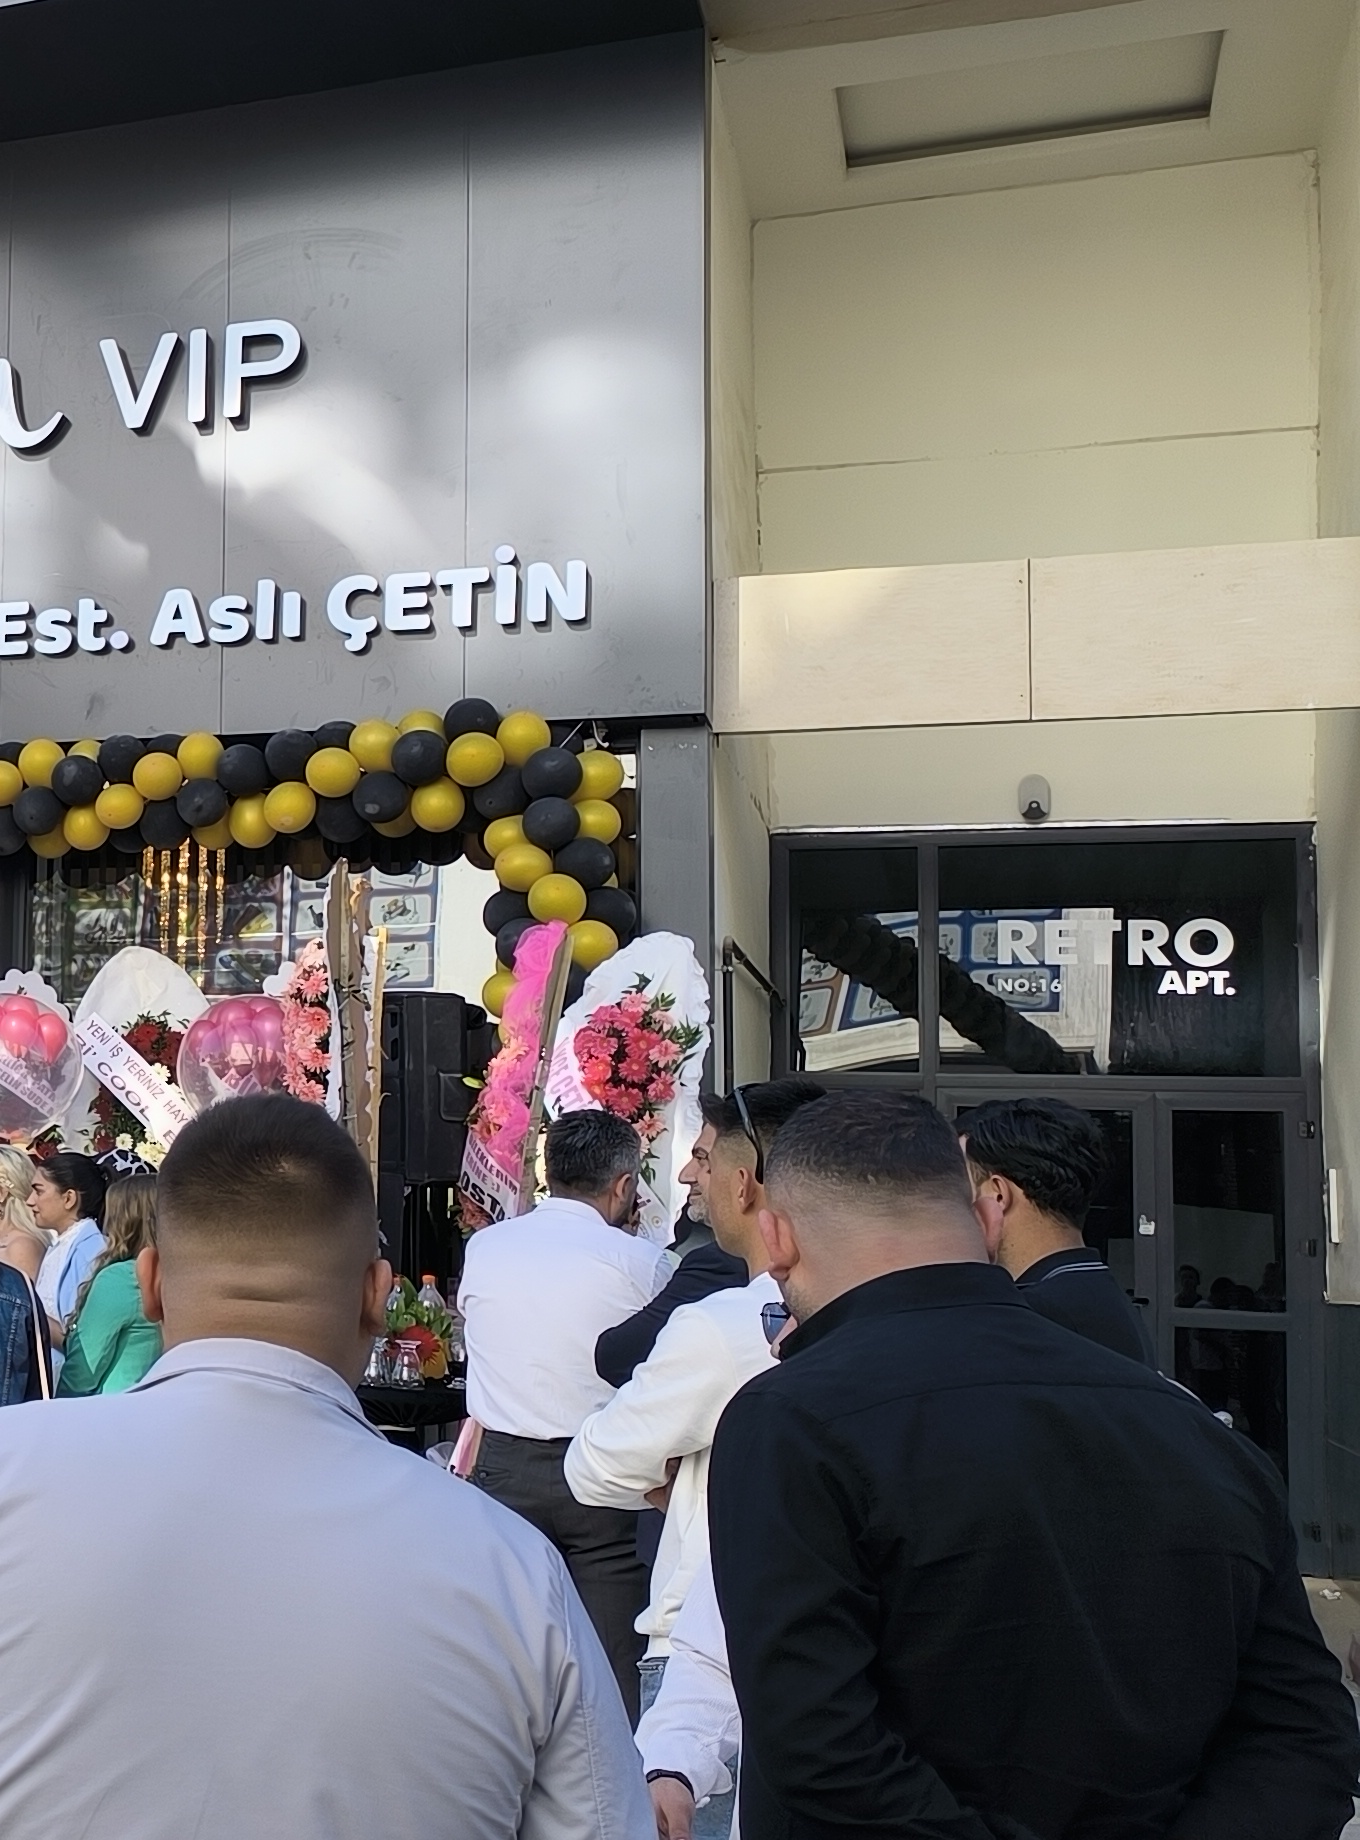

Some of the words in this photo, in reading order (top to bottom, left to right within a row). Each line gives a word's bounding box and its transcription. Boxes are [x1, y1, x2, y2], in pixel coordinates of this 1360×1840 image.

[99, 319, 305, 430] VIP
[150, 579, 303, 646] Aslı
[326, 544, 588, 652] ÇETİN
[997, 918, 1235, 967] RETRO
[997, 978, 1063, 993] NO:16
[1157, 970, 1236, 996] APT.
[86, 1019, 115, 1046] YENİ
[108, 1041, 124, 1059] İŞ
[122, 1055, 166, 1100] YERİNİZ
